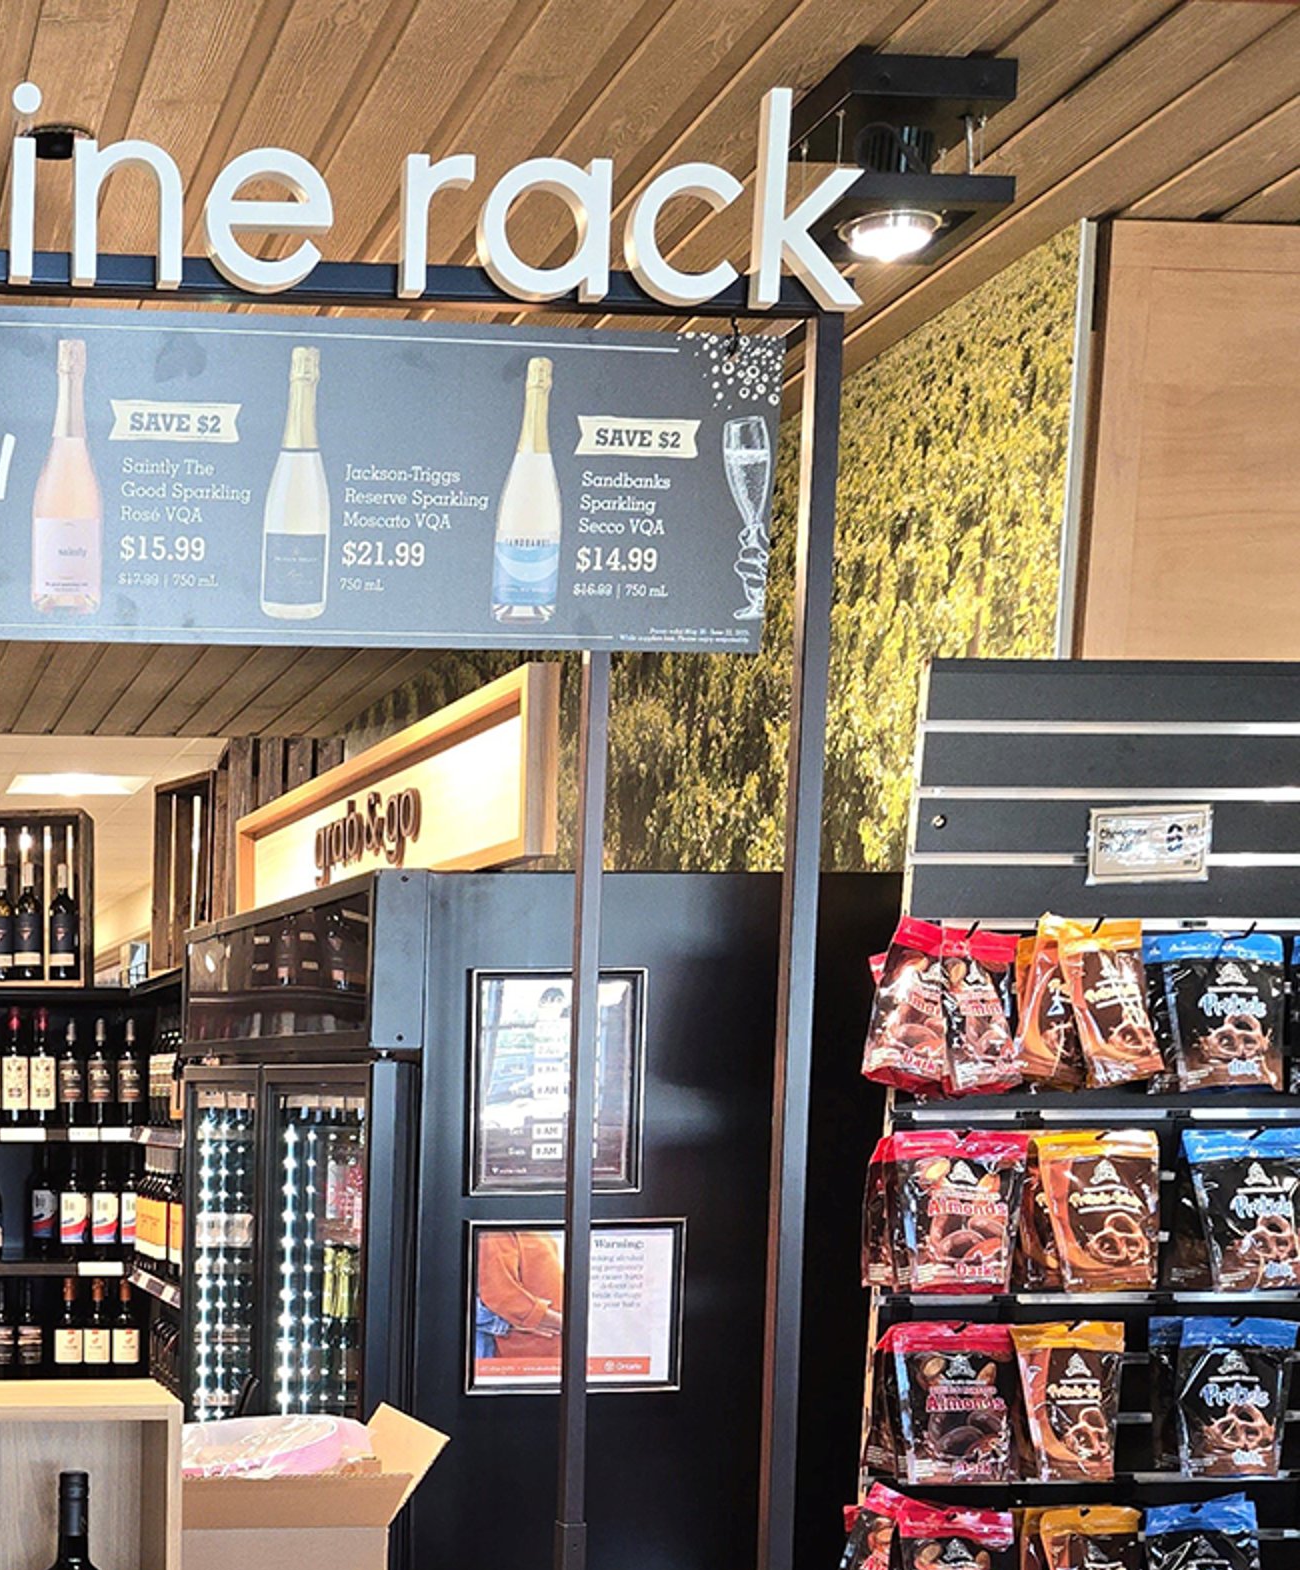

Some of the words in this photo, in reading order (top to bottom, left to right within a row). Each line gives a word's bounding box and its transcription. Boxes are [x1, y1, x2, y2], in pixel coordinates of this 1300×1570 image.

[397, 87, 863, 311] rack
[129, 412, 191, 433] SAVE
[196, 414, 222, 434] $2
[595, 428, 654, 448] SAVE
[658, 430, 682, 449] $2
[121, 457, 180, 478] Saintly
[184, 459, 215, 477] The
[345, 464, 461, 485] Jackson-Triggs
[581, 471, 672, 490] Sandbanks
[120, 482, 167, 499] Good
[172, 484, 252, 504] Sparkling
[345, 488, 408, 506] Reserve
[411, 490, 489, 510] Sparkling
[580, 494, 657, 515] Sparkling
[120, 506, 161, 523] Rosé
[165, 507, 204, 525] VQA
[343, 511, 411, 530] Moscato
[414, 513, 452, 531] VQA
[578, 517, 625, 535] Secco
[629, 520, 665, 537] VQA
[119, 535, 206, 563] $15.99
[341, 540, 426, 568] $21.99
[575, 546, 659, 573] $14.99
[172, 573, 195, 588] 750
[339, 577, 361, 591] 750
[625, 584, 648, 597] 750
[927, 1199, 1009, 1217] Almonds
[926, 1395, 1008, 1413] Almonds
